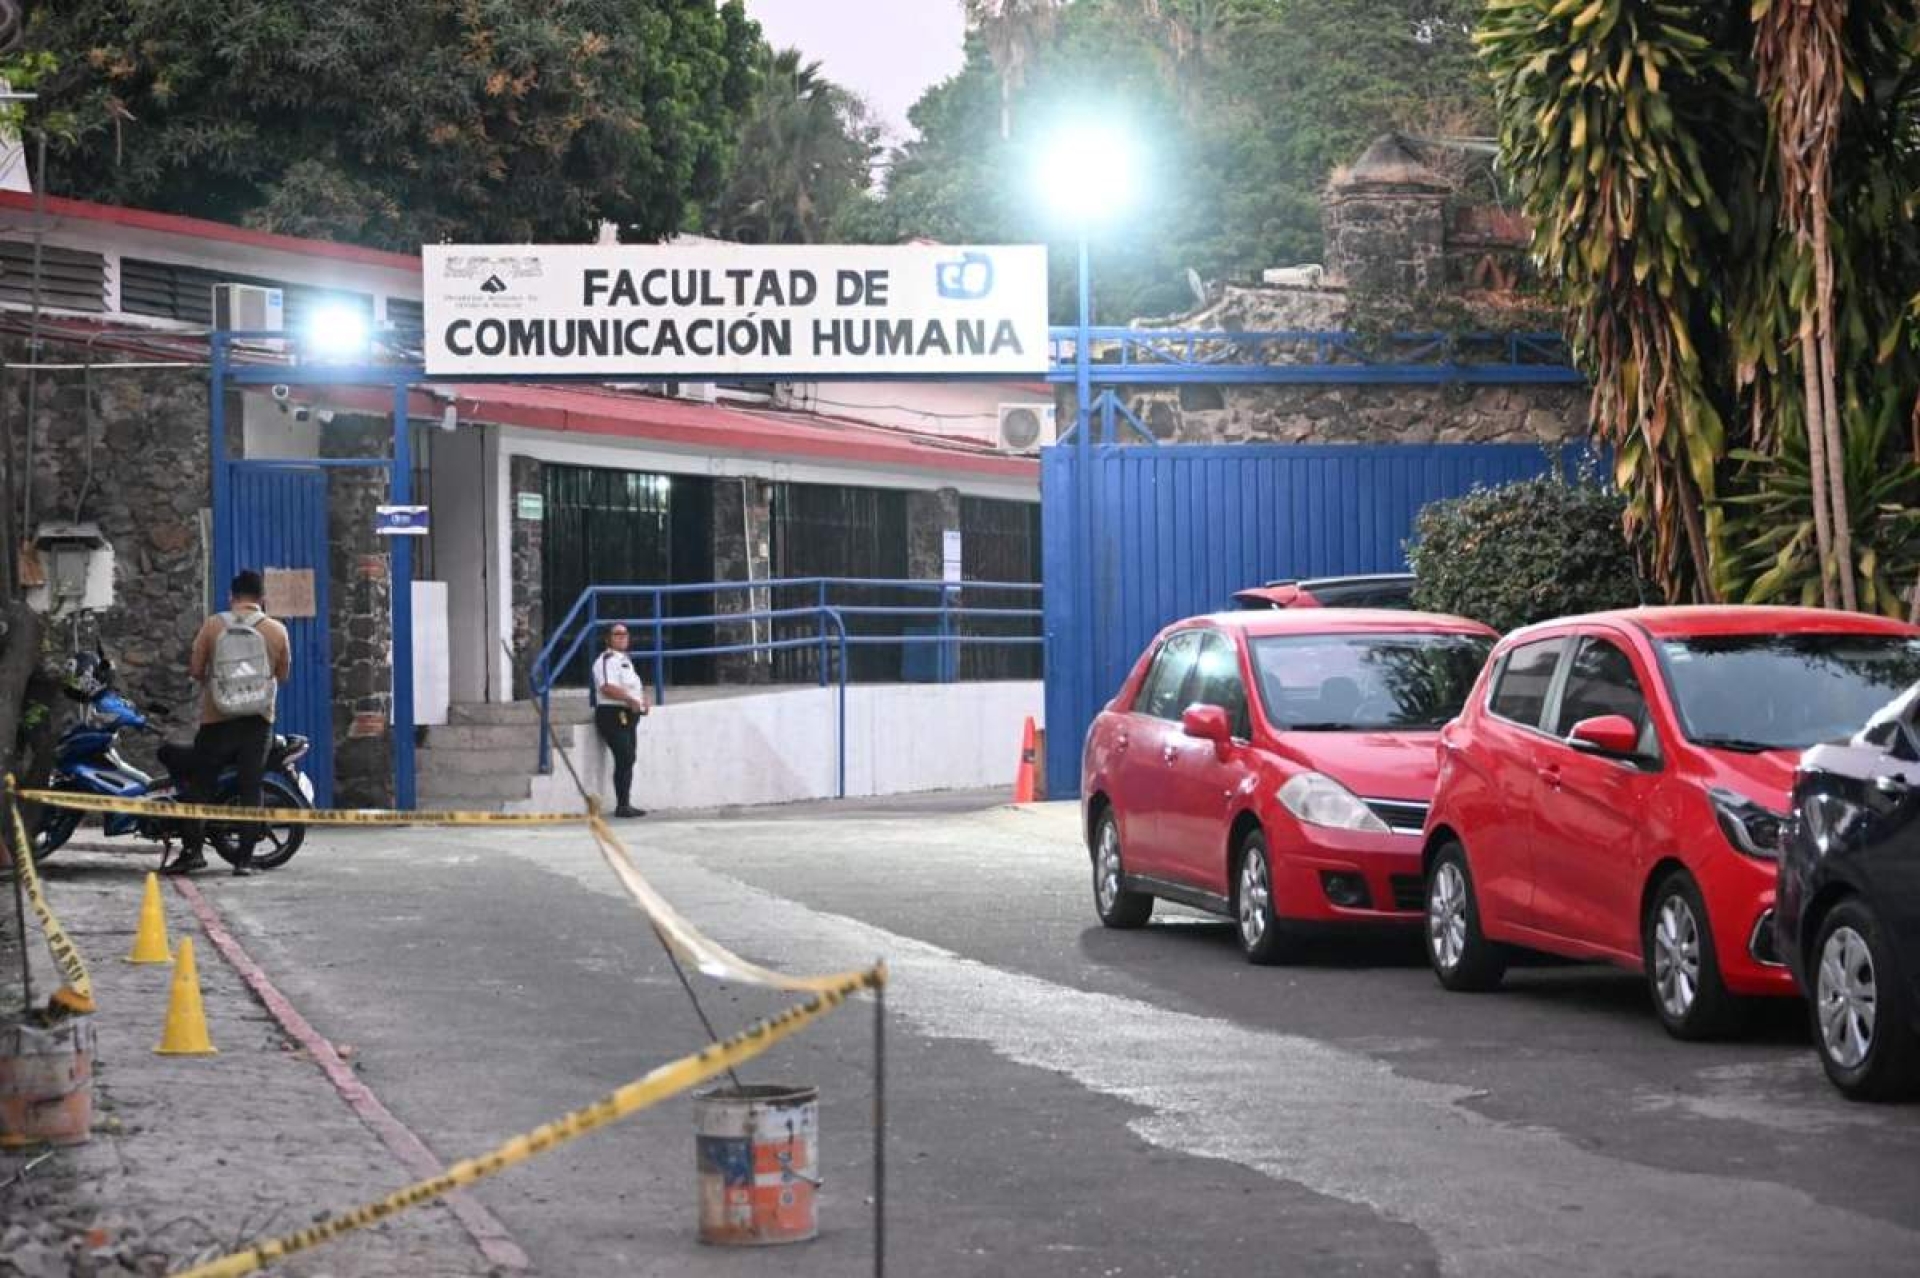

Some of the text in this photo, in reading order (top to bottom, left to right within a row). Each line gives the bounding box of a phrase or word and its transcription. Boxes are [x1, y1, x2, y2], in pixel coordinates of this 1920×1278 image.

[583, 269, 889, 306] FACULTAD DE
[444, 312, 1024, 357] COMUNICACIÓN HUMANA
